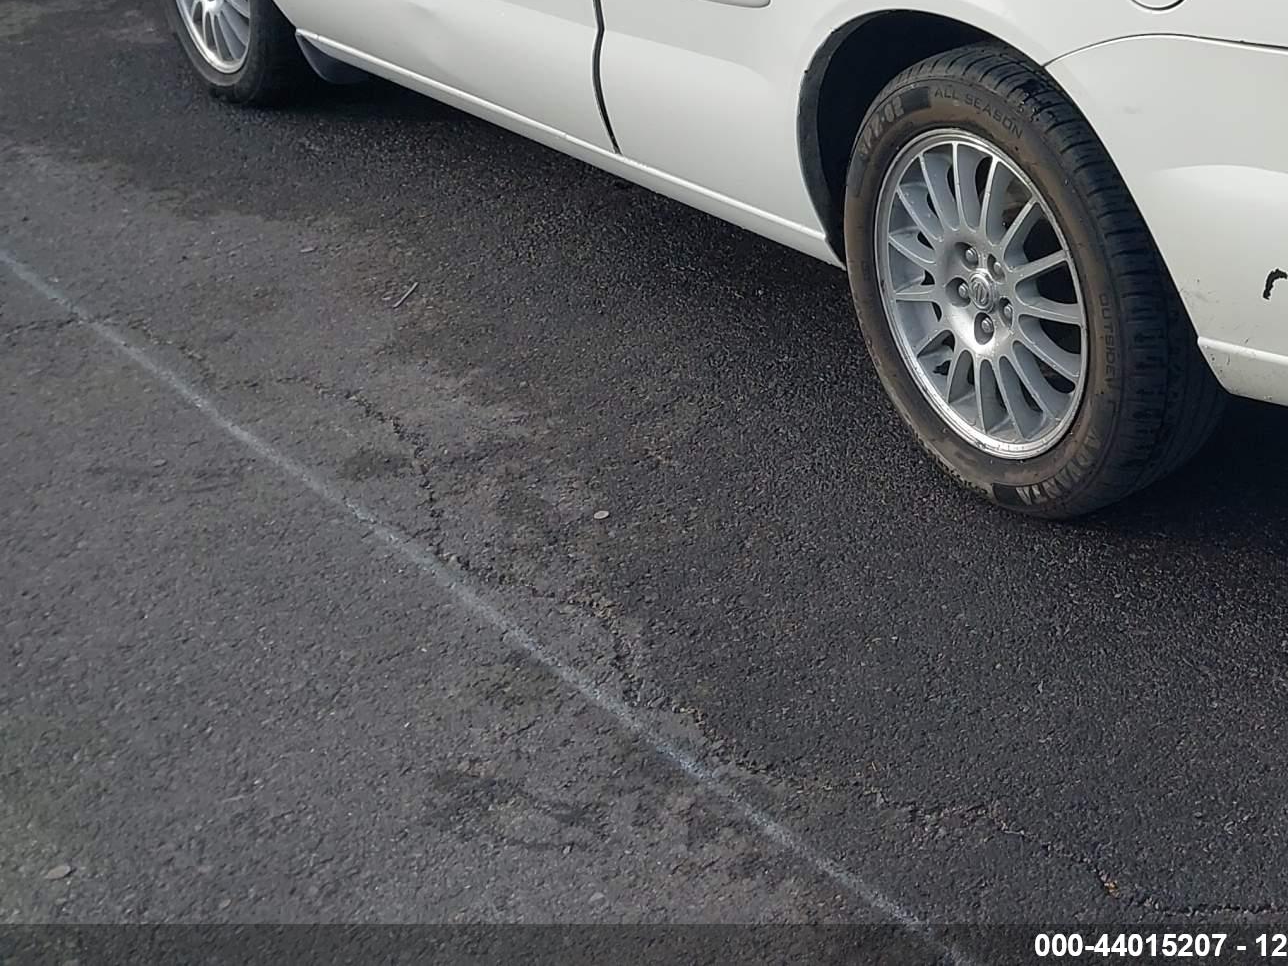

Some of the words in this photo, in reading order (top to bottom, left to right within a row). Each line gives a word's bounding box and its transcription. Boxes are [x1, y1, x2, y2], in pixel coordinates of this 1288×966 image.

[934, 87, 959, 100] ALL
[964, 93, 1023, 139] SEASON
[1099, 294, 1117, 379] OUTSIDE
